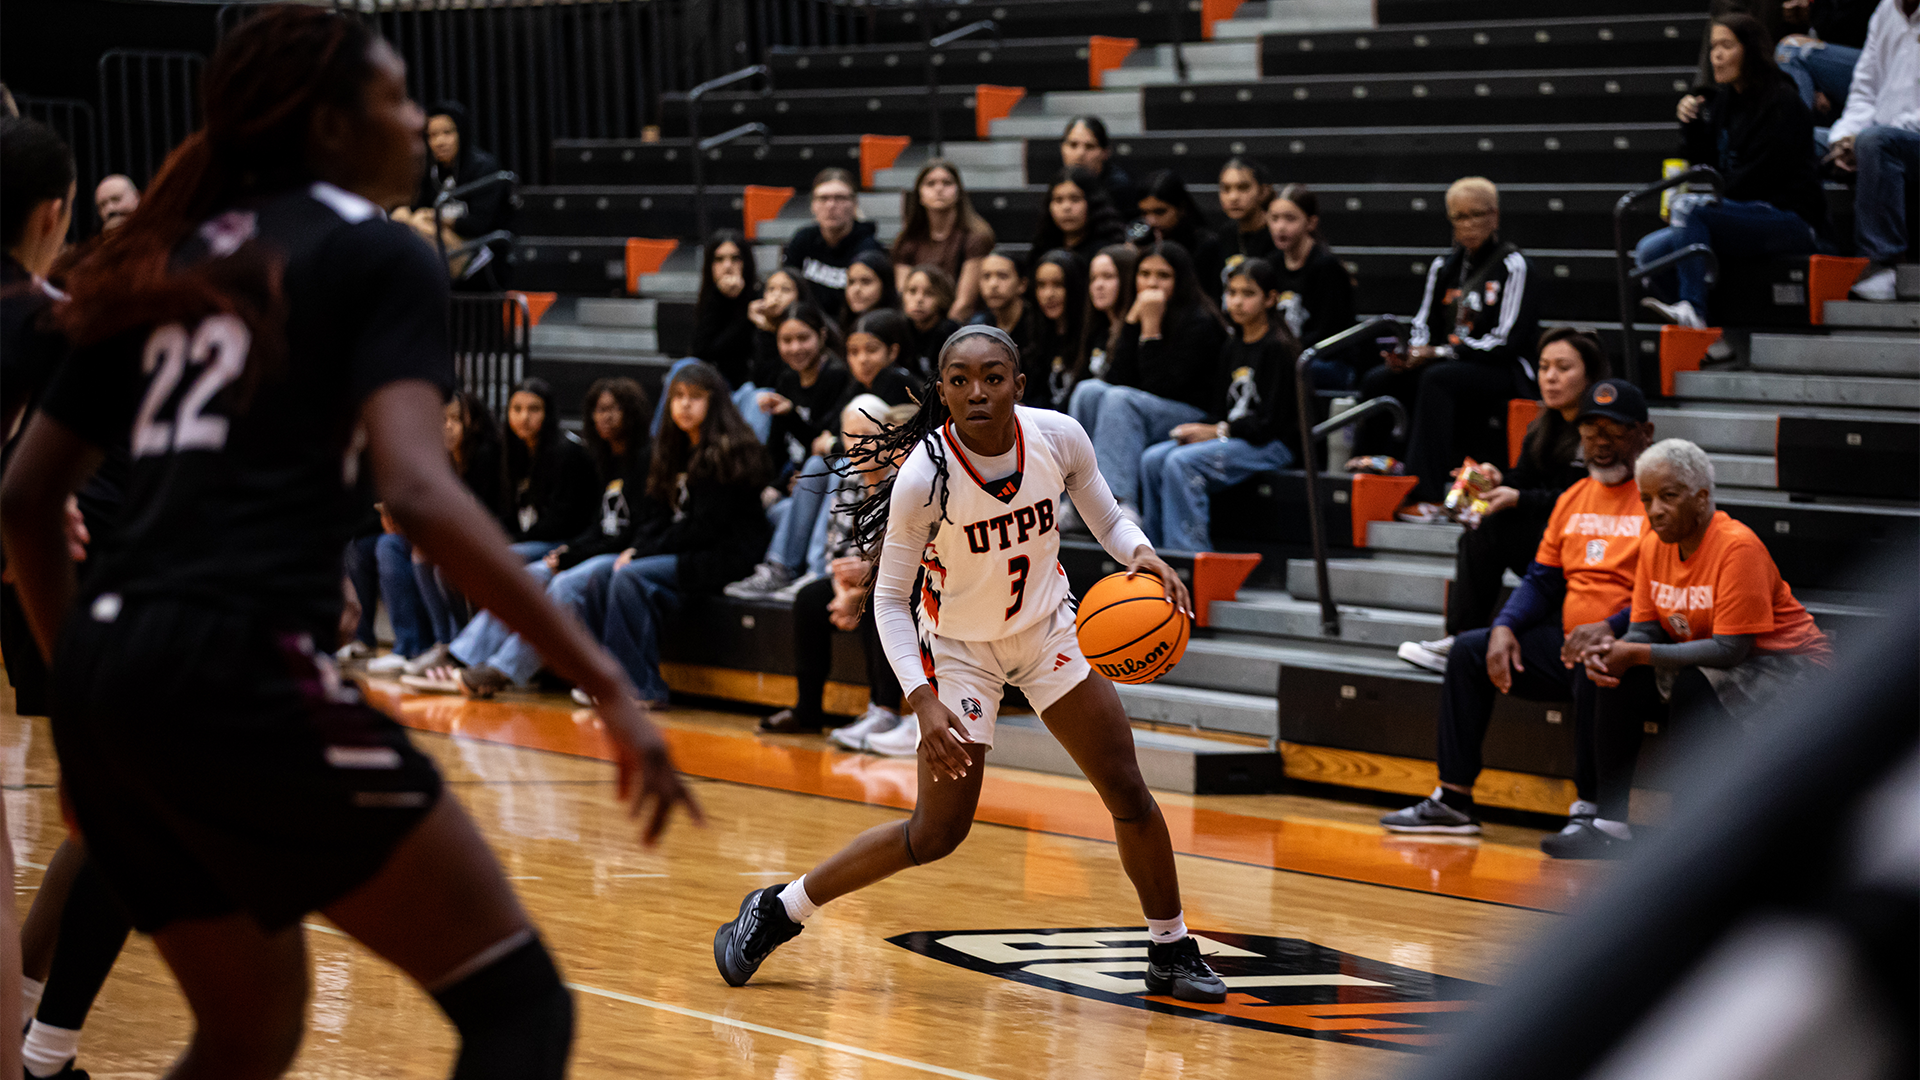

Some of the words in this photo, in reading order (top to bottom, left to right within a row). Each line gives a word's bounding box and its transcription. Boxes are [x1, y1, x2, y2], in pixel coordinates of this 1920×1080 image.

[131, 314, 251, 458] 22
[963, 498, 1054, 554] UTPB
[1005, 554, 1030, 622] 3
[1095, 641, 1169, 678] Wilson
